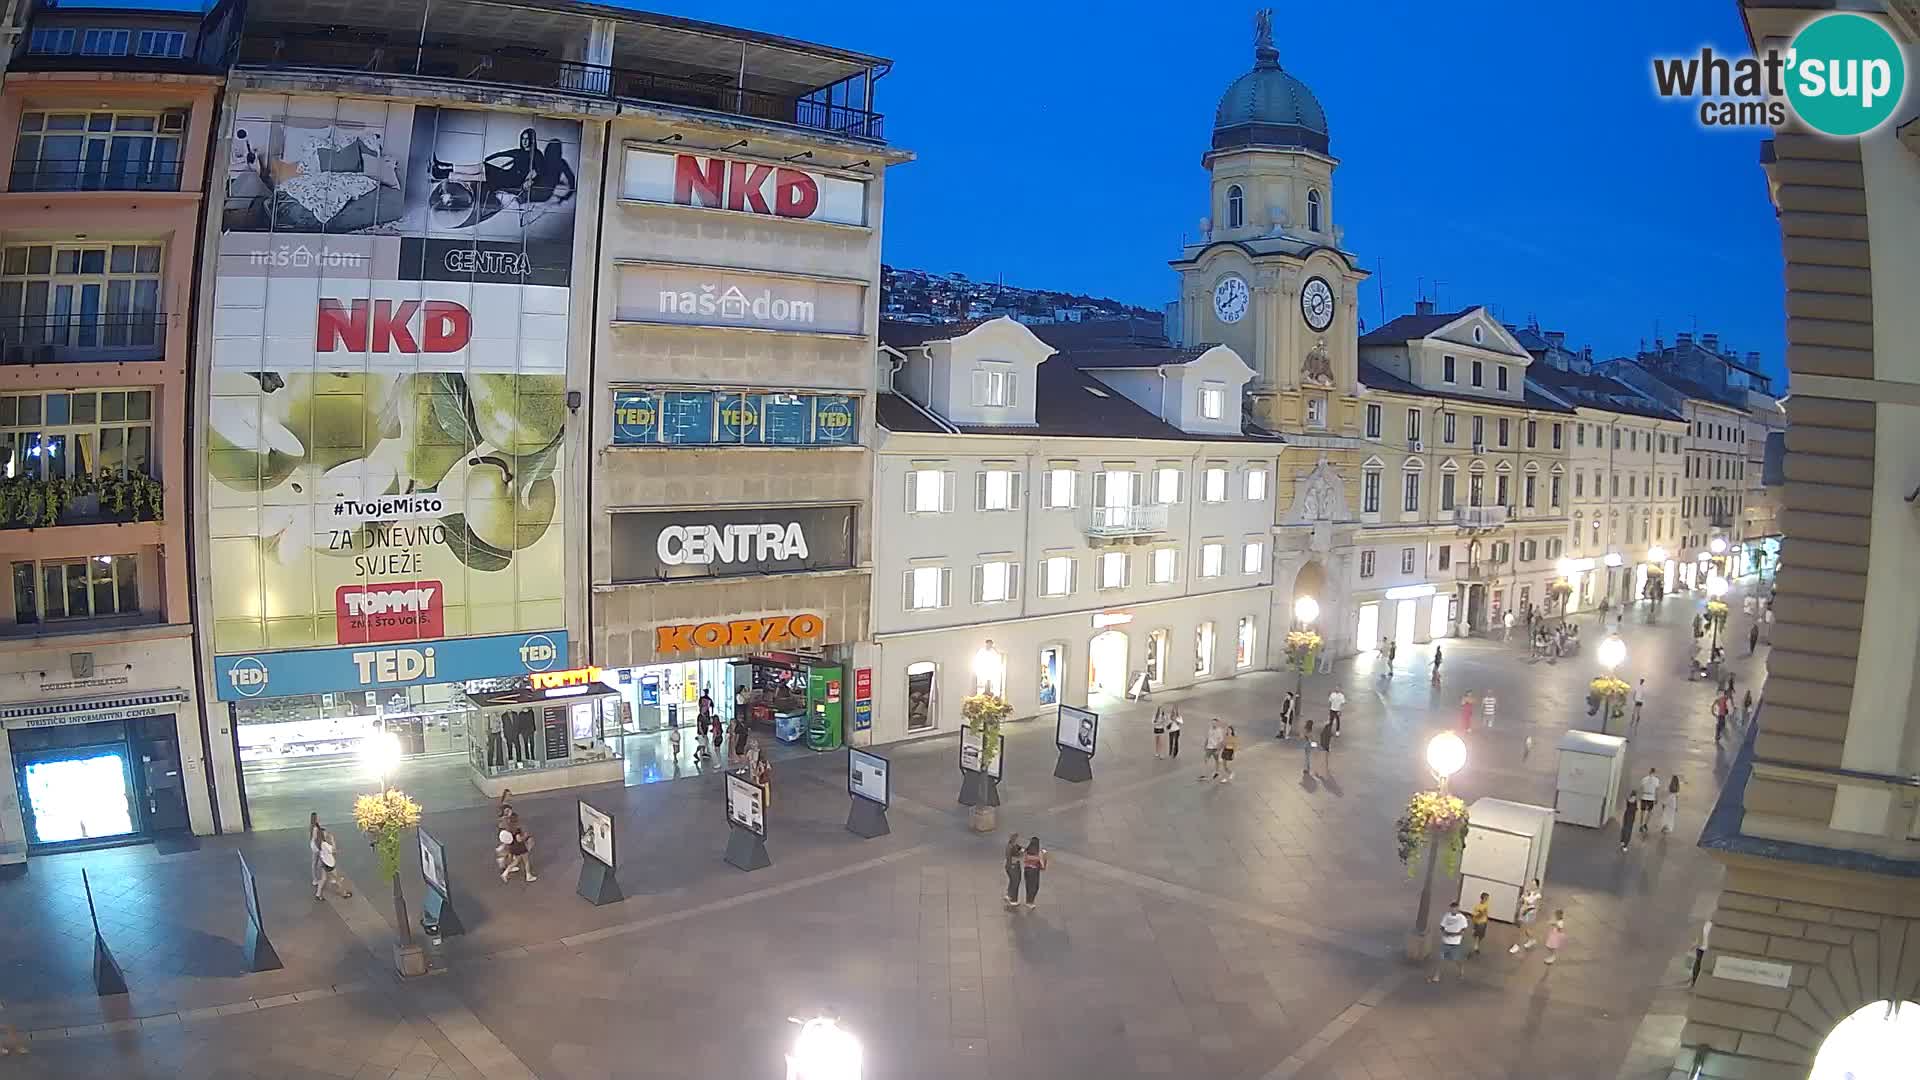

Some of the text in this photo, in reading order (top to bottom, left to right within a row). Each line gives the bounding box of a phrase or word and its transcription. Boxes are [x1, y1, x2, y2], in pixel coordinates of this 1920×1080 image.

[674, 153, 819, 219] NKD
[250, 246, 361, 268] naš dom
[445, 250, 531, 275] CENTRA
[659, 283, 815, 322] naš dom
[317, 297, 472, 353] NKD
[616, 408, 655, 425] TEDi
[721, 409, 758, 426] TEDi
[818, 411, 851, 428] TEDi
[333, 498, 442, 518] #TvojeMisto
[329, 525, 447, 550] ZA DNEVNO
[656, 522, 809, 565] CENTRA
[355, 549, 423, 576] SVJEŽE
[344, 587, 436, 616] TOMMY
[656, 613, 824, 653] KORZO
[519, 642, 556, 662] TEDi
[228, 667, 269, 686] TEDi
[353, 647, 436, 685] TEDi
[529, 666, 602, 691] TOMMY
[126, 707, 156, 718] CENTAR
